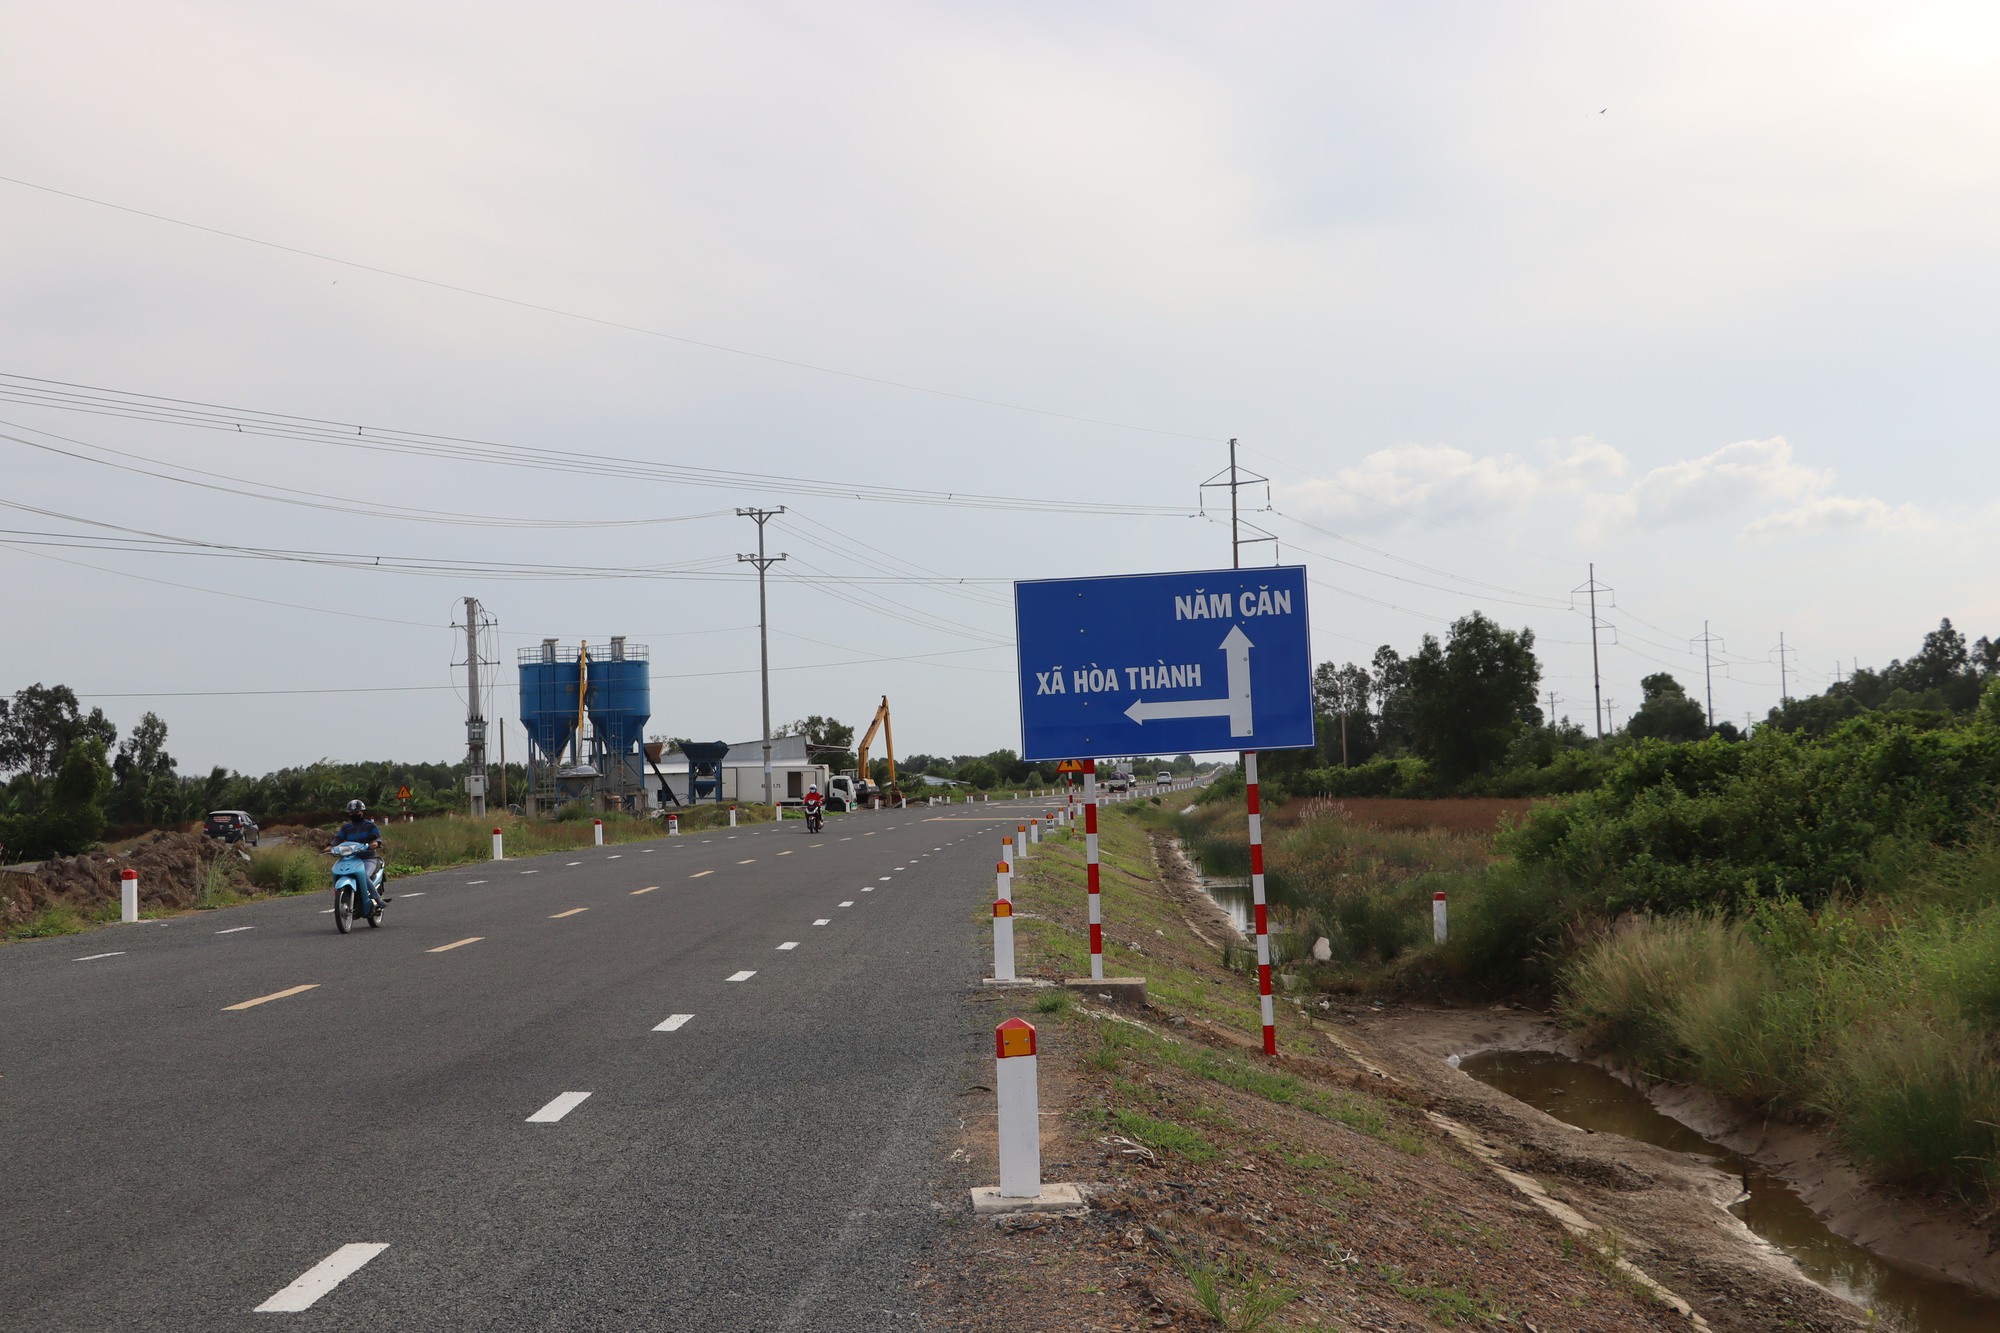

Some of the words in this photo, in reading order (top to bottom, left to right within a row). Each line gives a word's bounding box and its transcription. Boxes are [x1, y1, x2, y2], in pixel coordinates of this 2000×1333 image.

[1175, 589, 1232, 620] NĂM
[1239, 585, 1291, 616] CĂN
[1036, 665, 1066, 695] XÃ
[1073, 662, 1119, 693] HÒA
[1125, 659, 1202, 690] THÀNH
